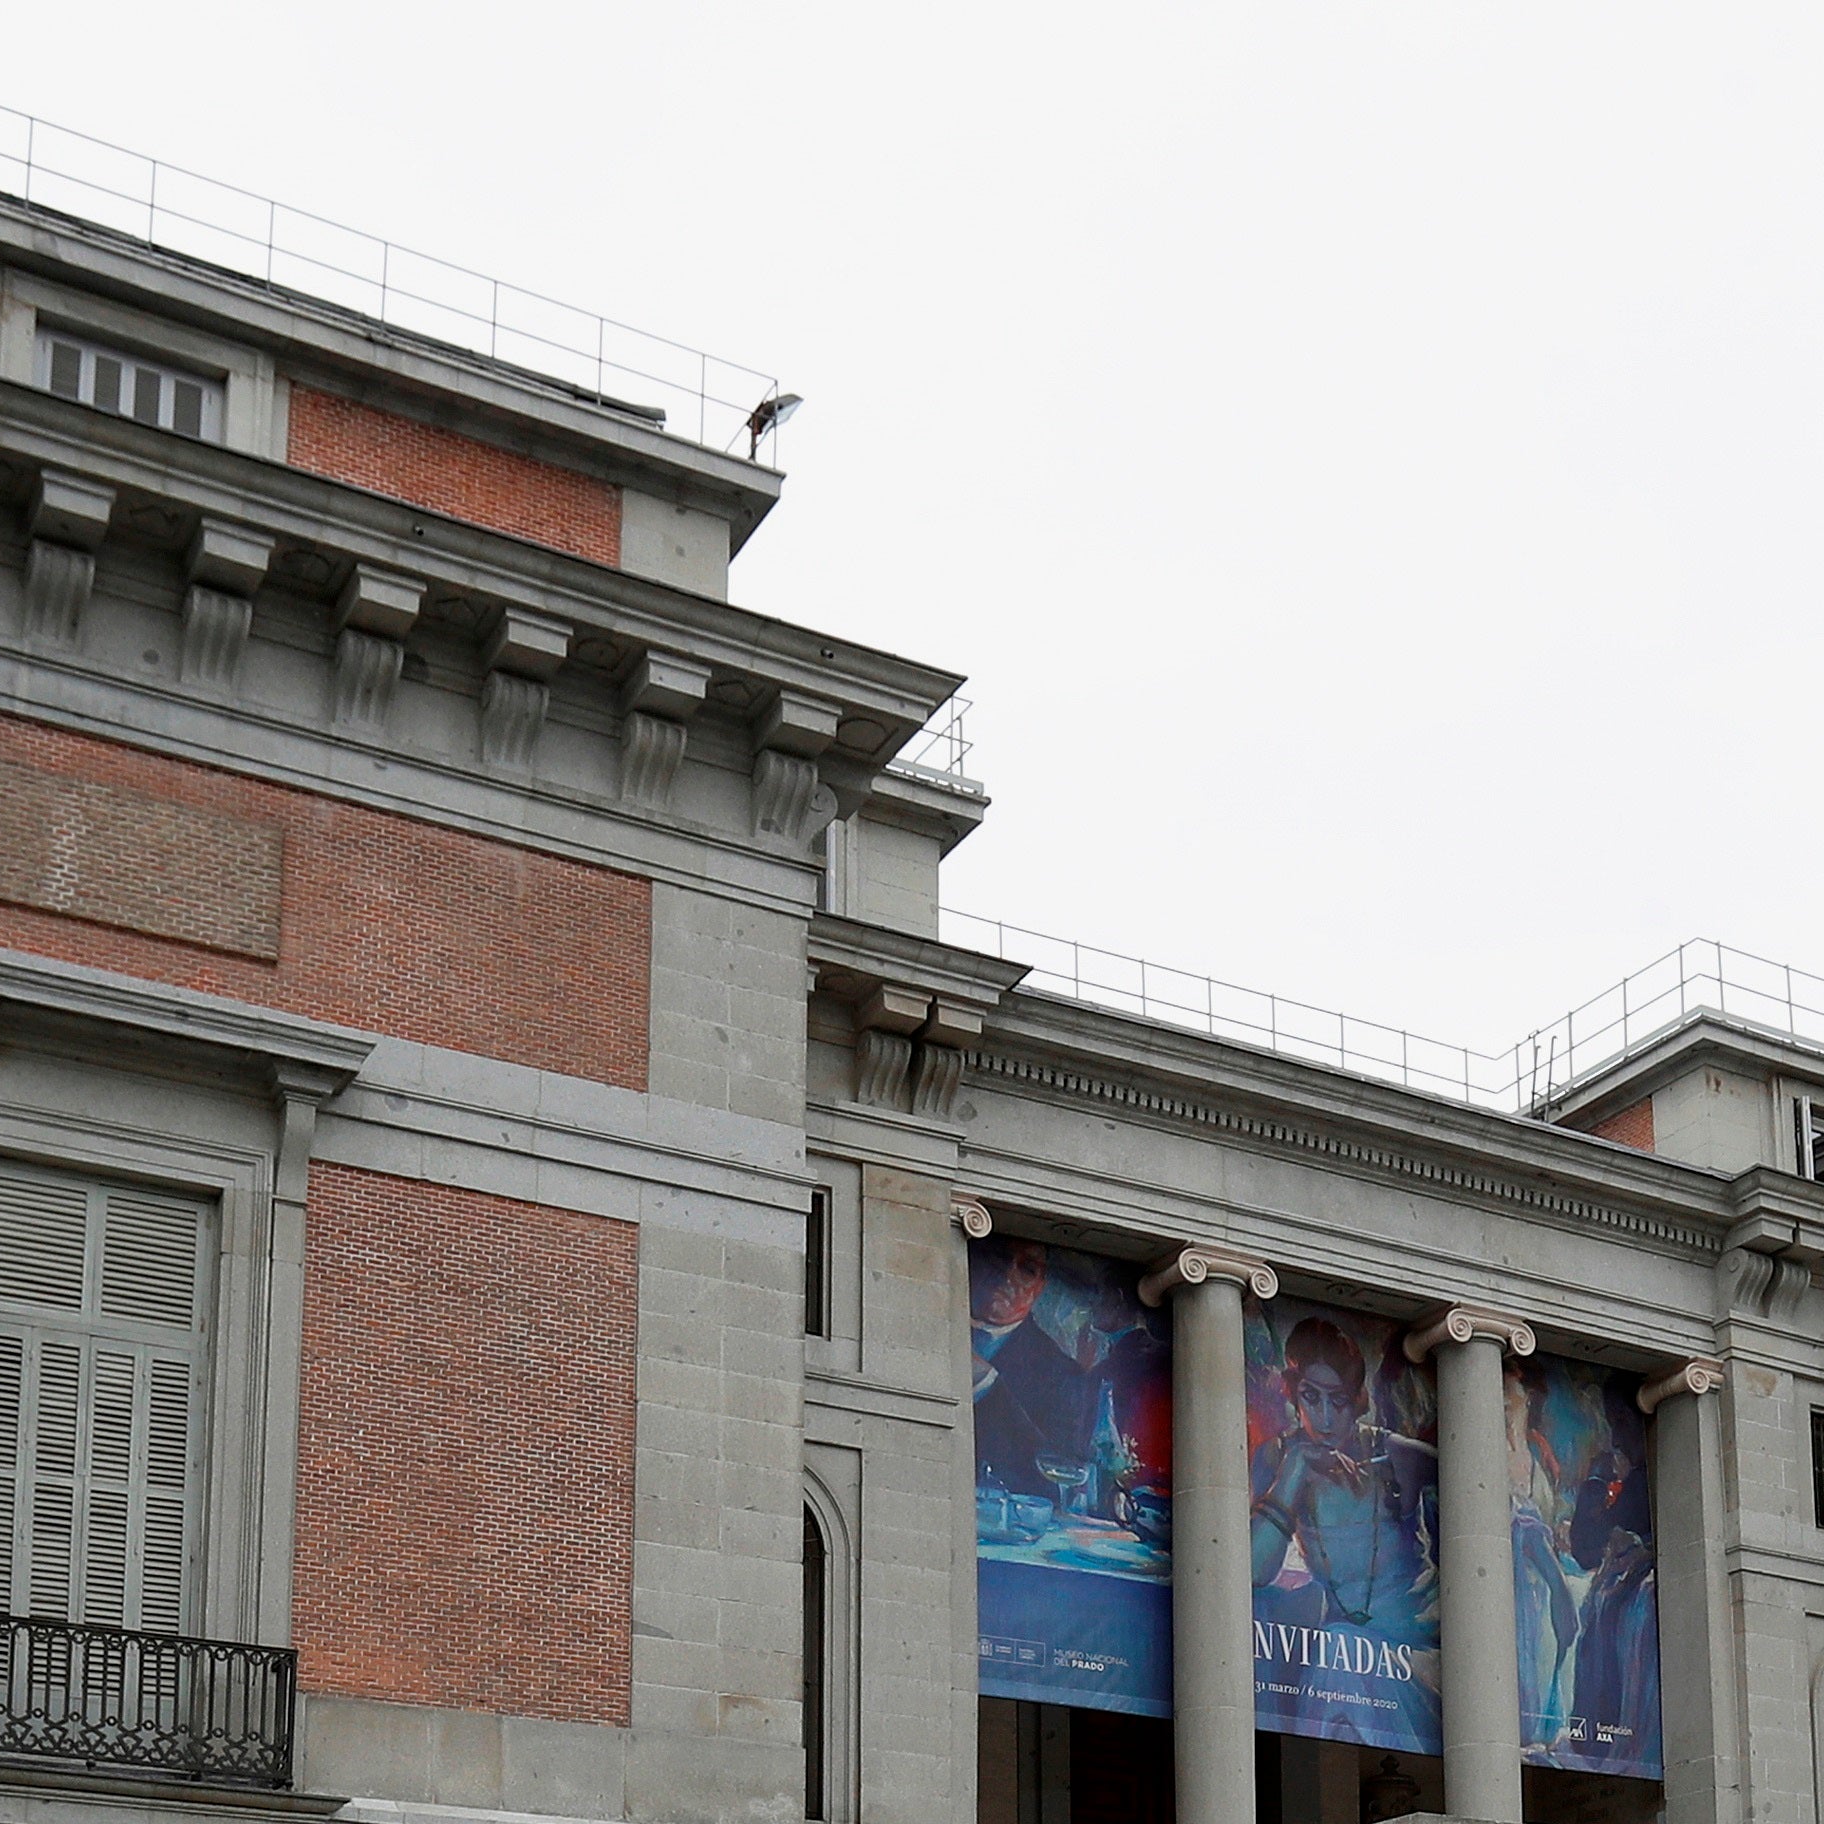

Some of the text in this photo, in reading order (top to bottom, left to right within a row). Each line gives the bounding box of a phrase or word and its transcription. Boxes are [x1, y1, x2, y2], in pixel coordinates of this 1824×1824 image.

[1054, 1648, 1130, 1668] MUSEO NACIONAL
[1254, 1620, 1412, 1682] NVITADAS
[1054, 1657, 1105, 1672] DEL PRADO
[1254, 1681, 1266, 1693] 31
[1268, 1683, 1300, 1696] marzo
[1307, 1686, 1315, 1697] 6
[1316, 1687, 1372, 1706] septiembre
[1372, 1698, 1399, 1710] 2020
[1596, 1722, 1634, 1736] fundación
[1596, 1732, 1614, 1743] AXA
